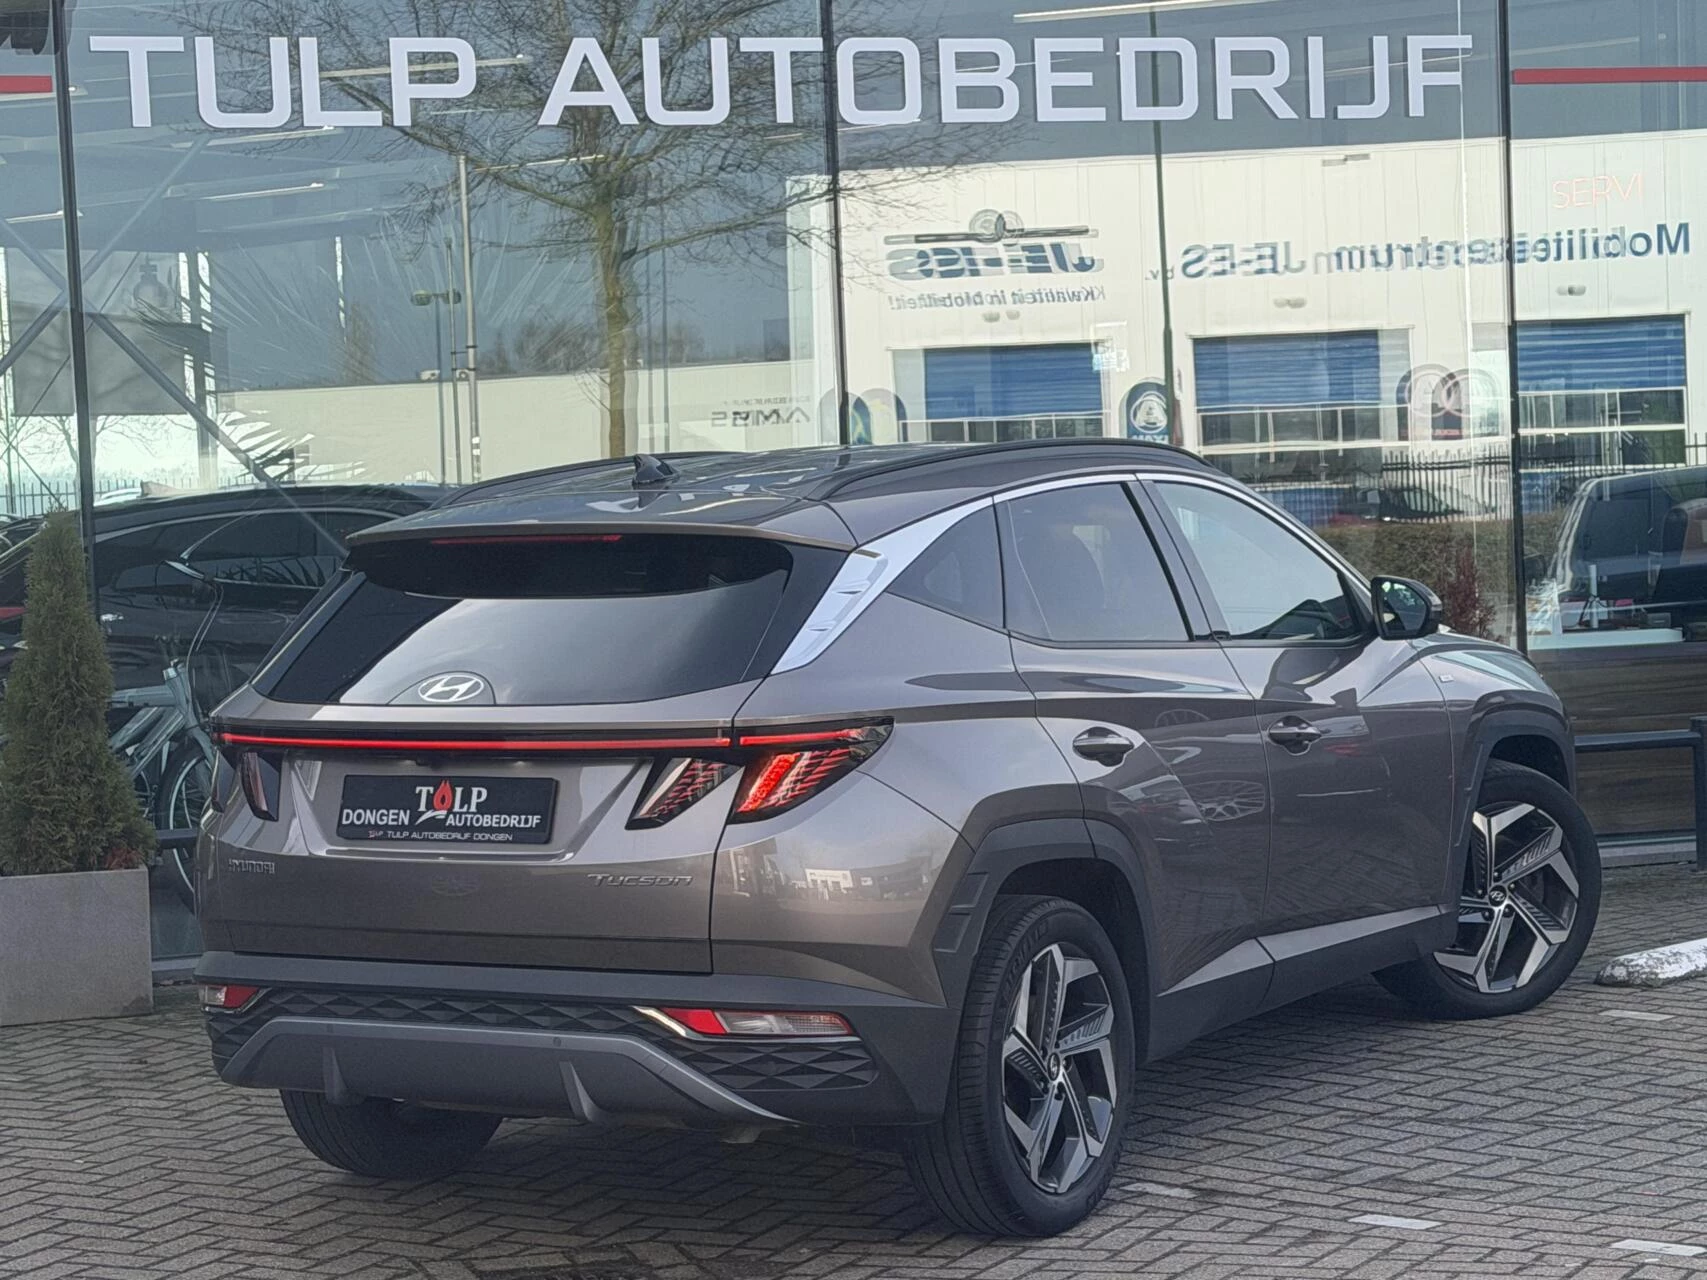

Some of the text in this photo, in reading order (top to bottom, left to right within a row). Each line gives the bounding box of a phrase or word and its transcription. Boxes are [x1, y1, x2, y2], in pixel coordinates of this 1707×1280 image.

[89, 34, 1473, 129] TULP AUTOBEDRIJF
[342, 809, 542, 828] DONGEN AUTOBEDRIJF
